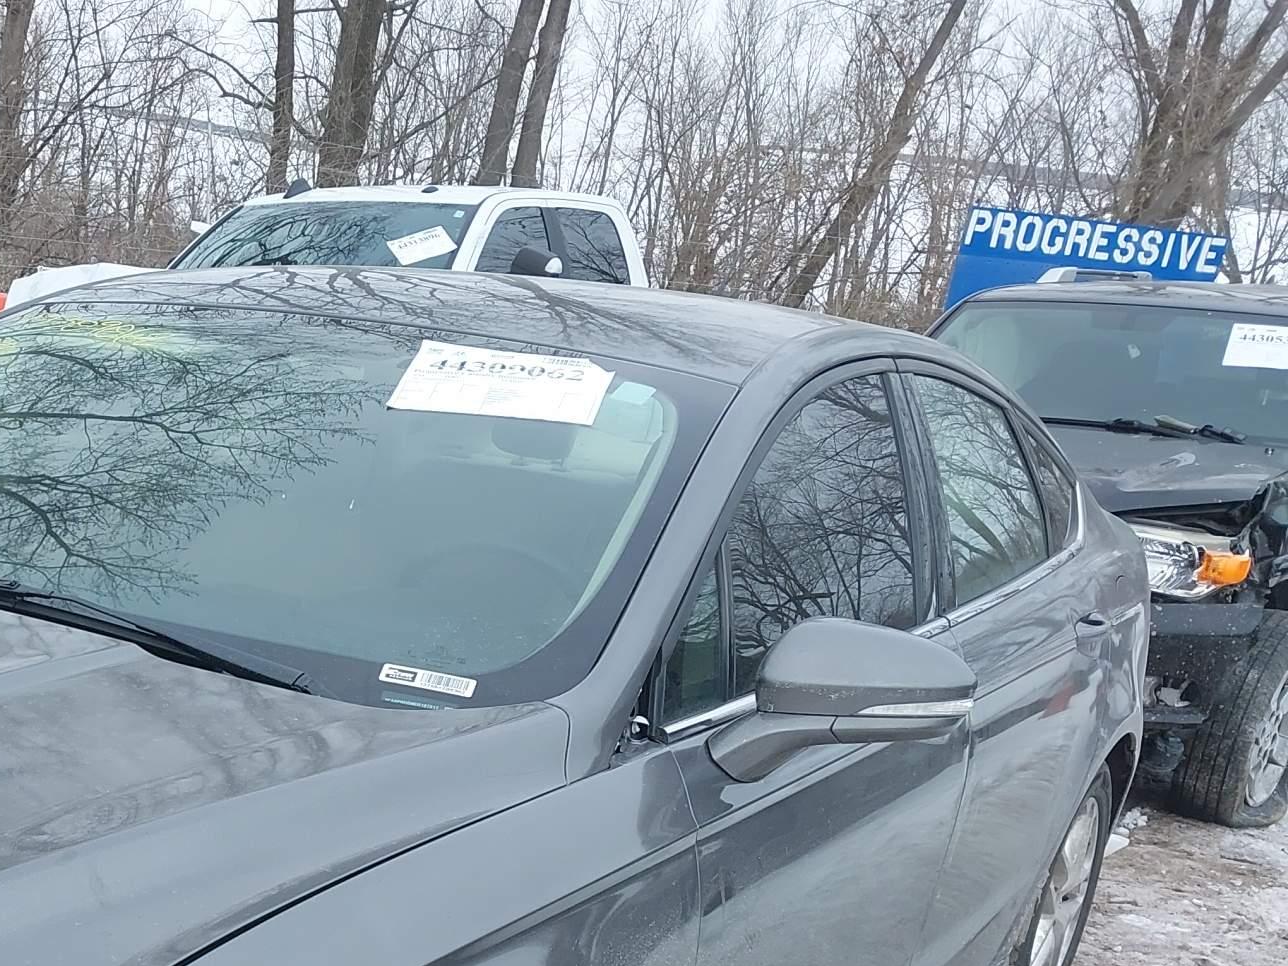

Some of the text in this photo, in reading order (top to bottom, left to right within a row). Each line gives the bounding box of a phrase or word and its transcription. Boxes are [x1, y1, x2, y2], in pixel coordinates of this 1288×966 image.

[964, 209, 1227, 274] PROGRESSIVE
[1239, 333, 1288, 345] 44305
[430, 359, 585, 381] 44309062
